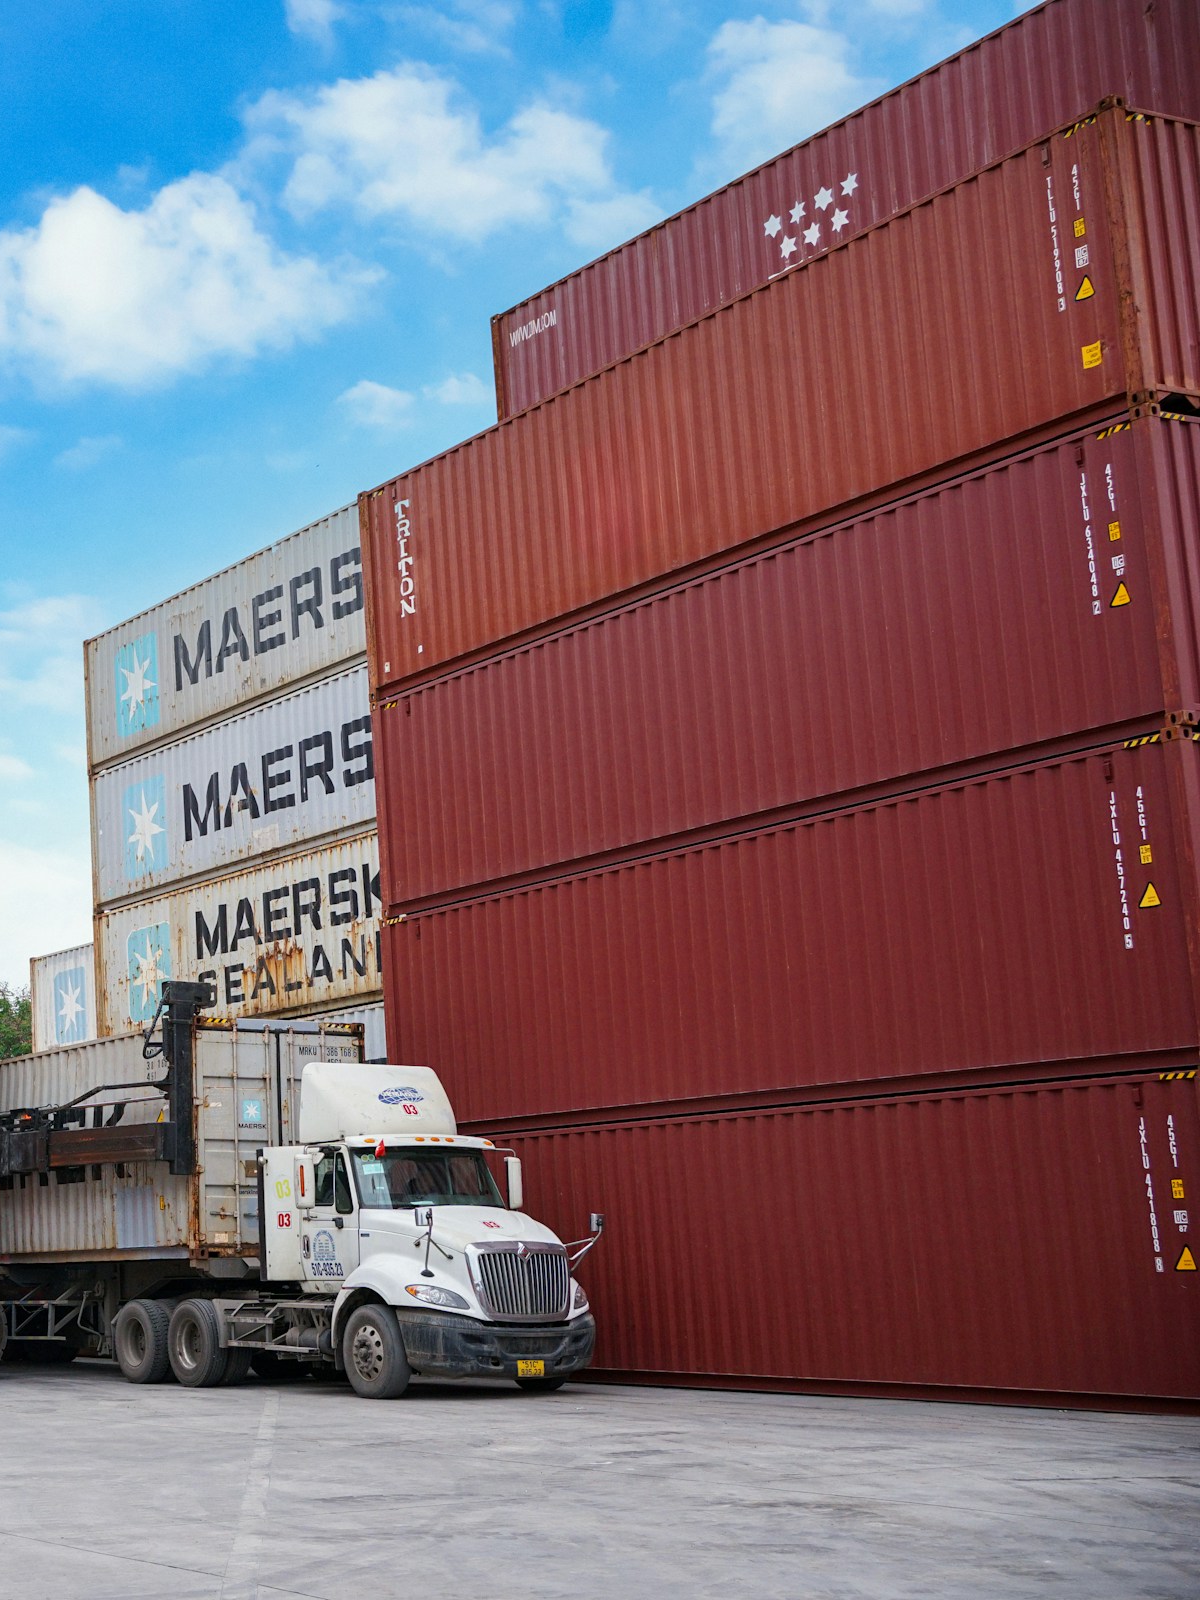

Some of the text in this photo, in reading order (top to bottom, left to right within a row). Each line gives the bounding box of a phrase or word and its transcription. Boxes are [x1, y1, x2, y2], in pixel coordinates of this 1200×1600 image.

[1071, 164, 1080, 211] 45G1
[1046, 176, 1066, 312] TLLU 519908 3
[1104, 463, 1116, 512] 45G1
[394, 499, 416, 618] TRITON
[1079, 472, 1101, 615] JXLU 634048 2
[1116, 567, 1125, 577] 87
[173, 547, 365, 692] MAERS
[182, 715, 375, 842] MAERS
[1135, 785, 1147, 840] 45G1
[1109, 791, 1133, 949] JXLU 457240 5
[198, 930, 382, 1009] SEALAN
[298, 1046, 318, 1056] MRKU
[403, 1104, 418, 1115] 03
[1166, 1114, 1178, 1168] 45G1
[275, 1179, 292, 1199] 03
[1138, 1116, 1164, 1273] JXLU 441808 8
[278, 1213, 291, 1228] 03
[482, 1221, 500, 1229] 03
[1178, 1224, 1188, 1233] 87
[525, 1360, 539, 1369] 51C
